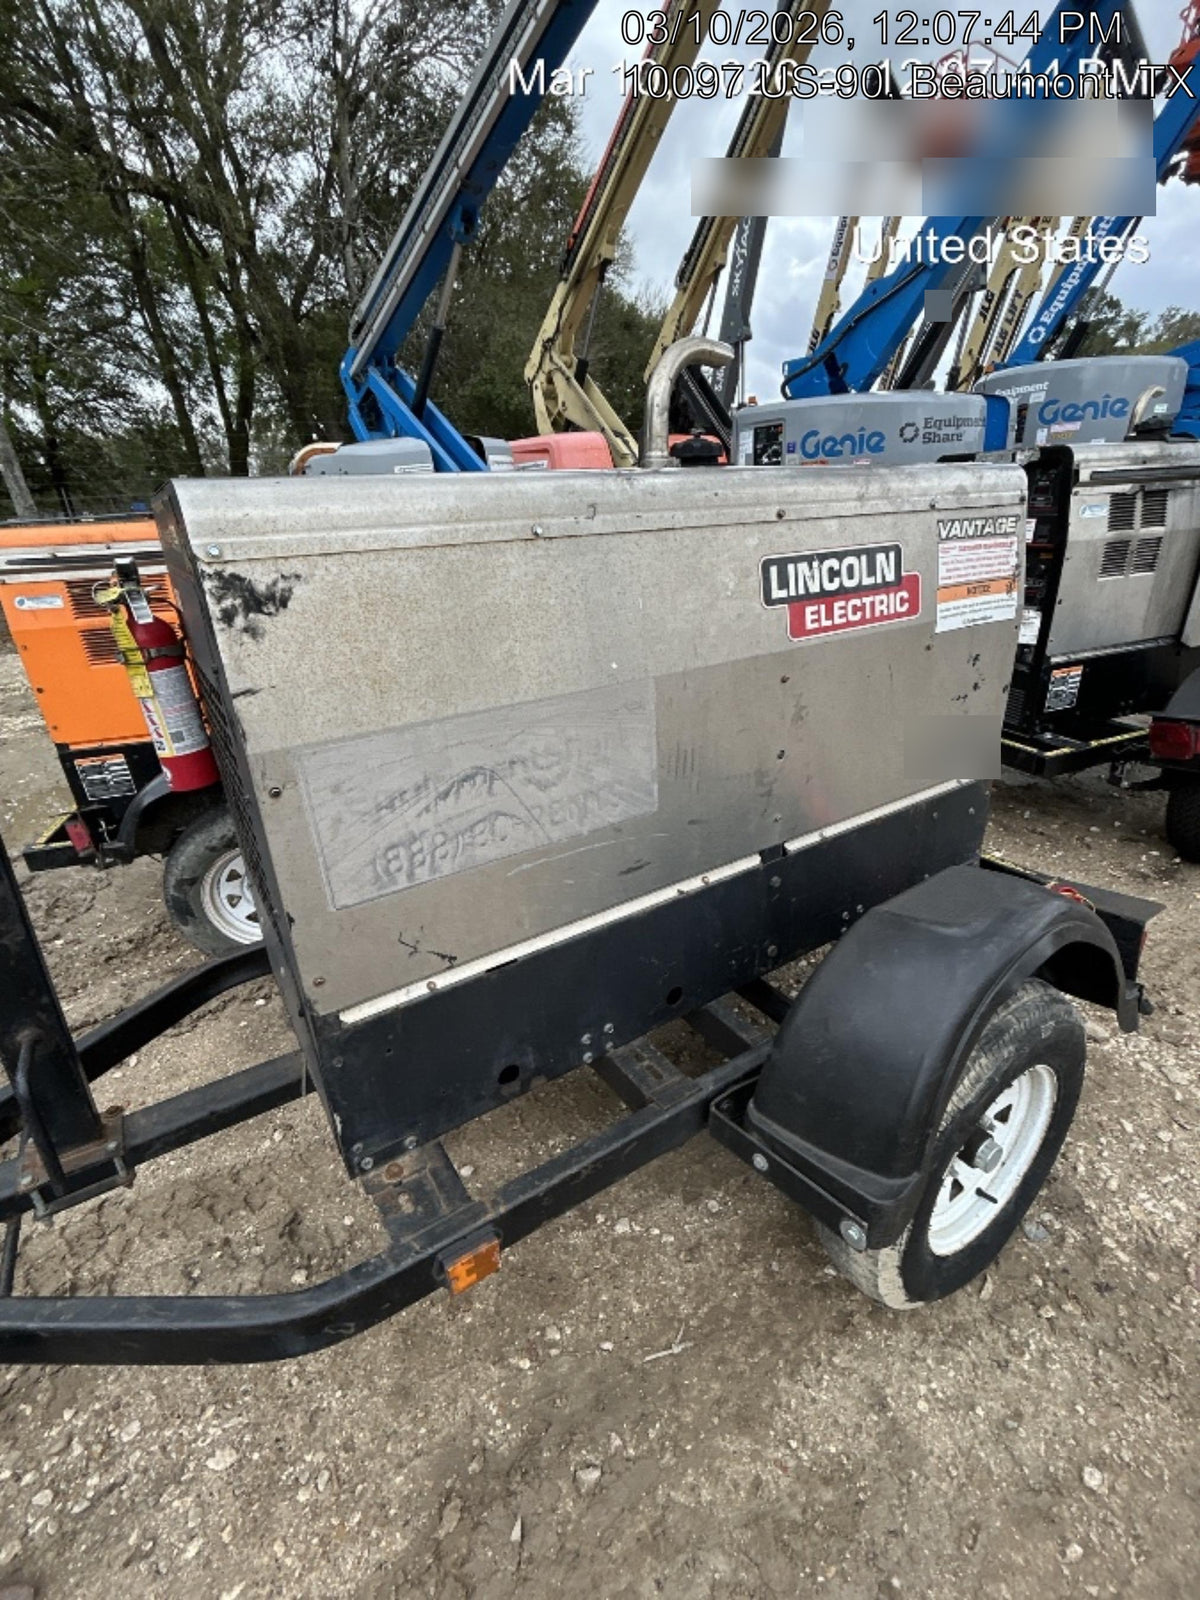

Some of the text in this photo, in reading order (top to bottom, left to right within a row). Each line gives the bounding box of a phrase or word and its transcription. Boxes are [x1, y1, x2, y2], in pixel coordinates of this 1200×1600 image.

[831, 216, 848, 257] Equip
[731, 216, 752, 297] SKYJAC
[1038, 393, 1130, 426] Genie
[801, 426, 886, 460] Genie
[922, 431, 964, 444] Share
[938, 516, 1017, 540] VANTAGE
[769, 551, 896, 600] LINCOLN
[804, 591, 910, 631] ELECTRIC
